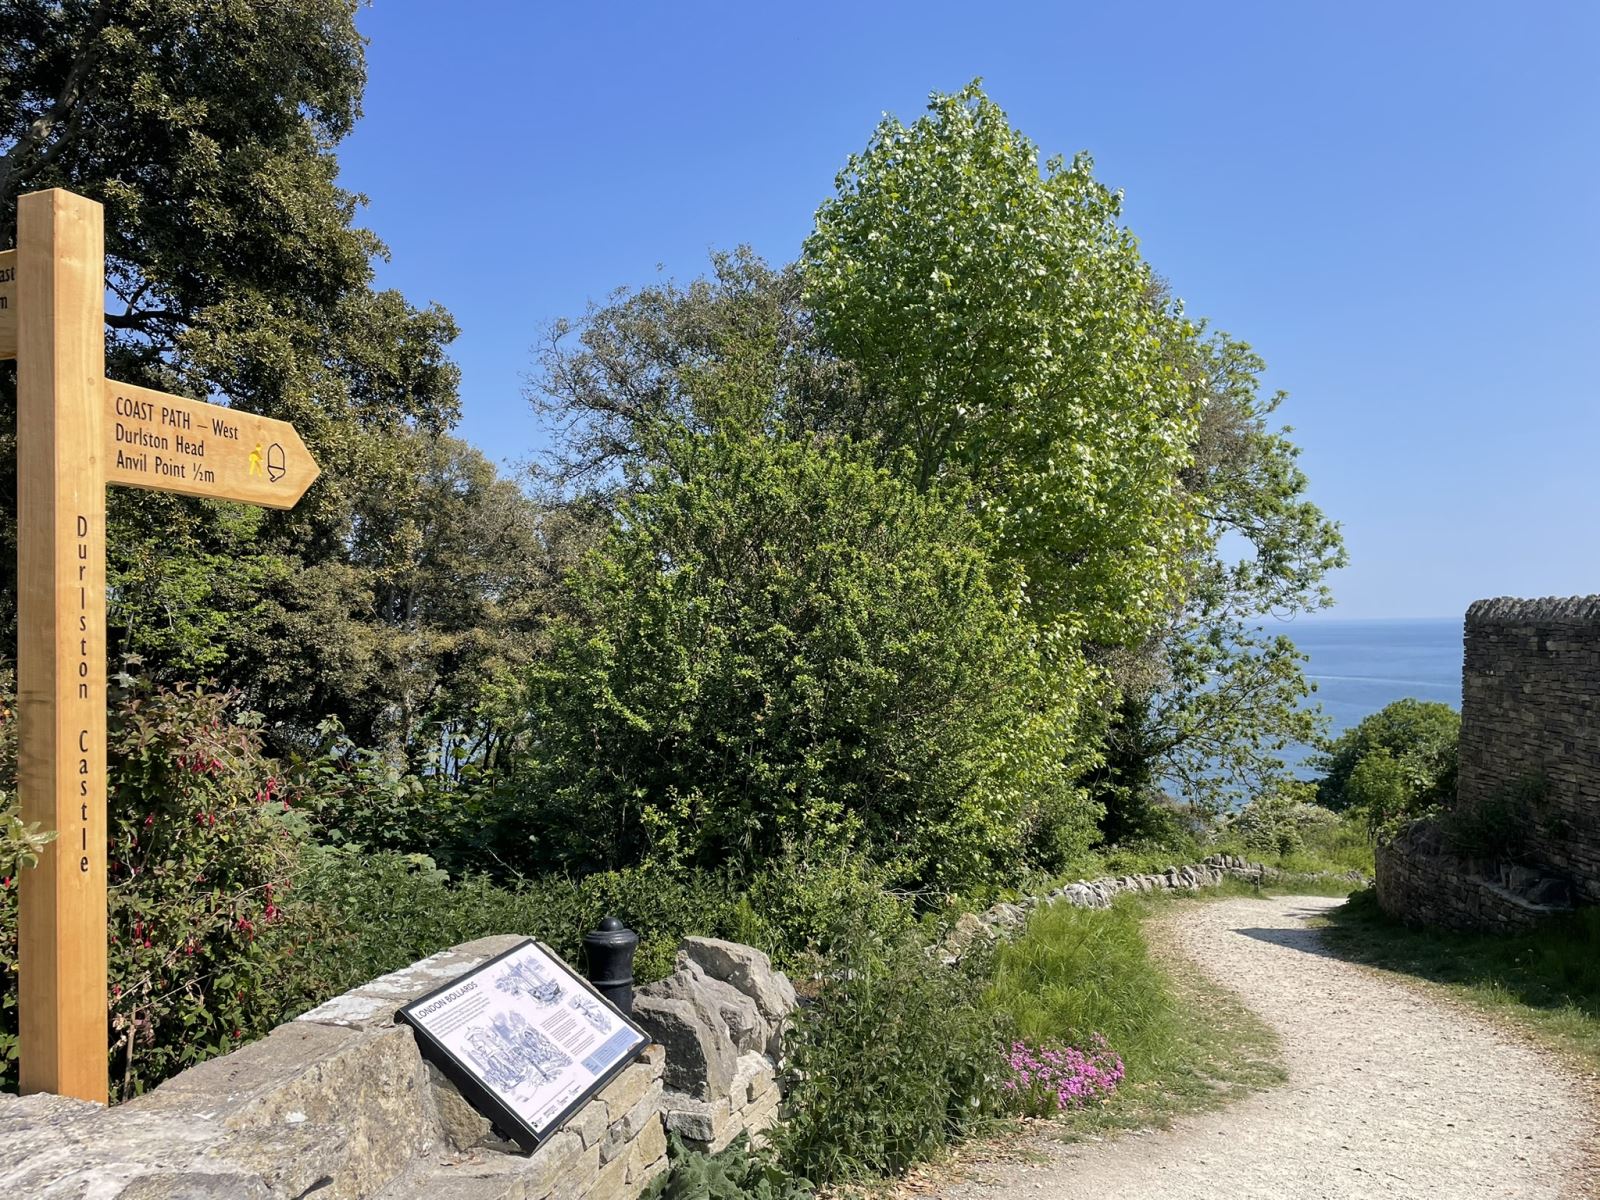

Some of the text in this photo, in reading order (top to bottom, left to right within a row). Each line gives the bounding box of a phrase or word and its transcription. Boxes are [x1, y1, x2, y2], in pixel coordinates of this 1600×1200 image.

[0, 267, 15, 283] ast
[115, 397, 154, 422] COAST
[162, 407, 191, 430] PATH
[212, 418, 239, 440] West
[116, 423, 204, 457] Durlston Head
[116, 449, 147, 472] Anvil
[155, 456, 186, 478] Point
[76, 515, 89, 873] Durlston Castle
[414, 998, 447, 1020] LONDON
[444, 981, 478, 1003] BOLLARDS
